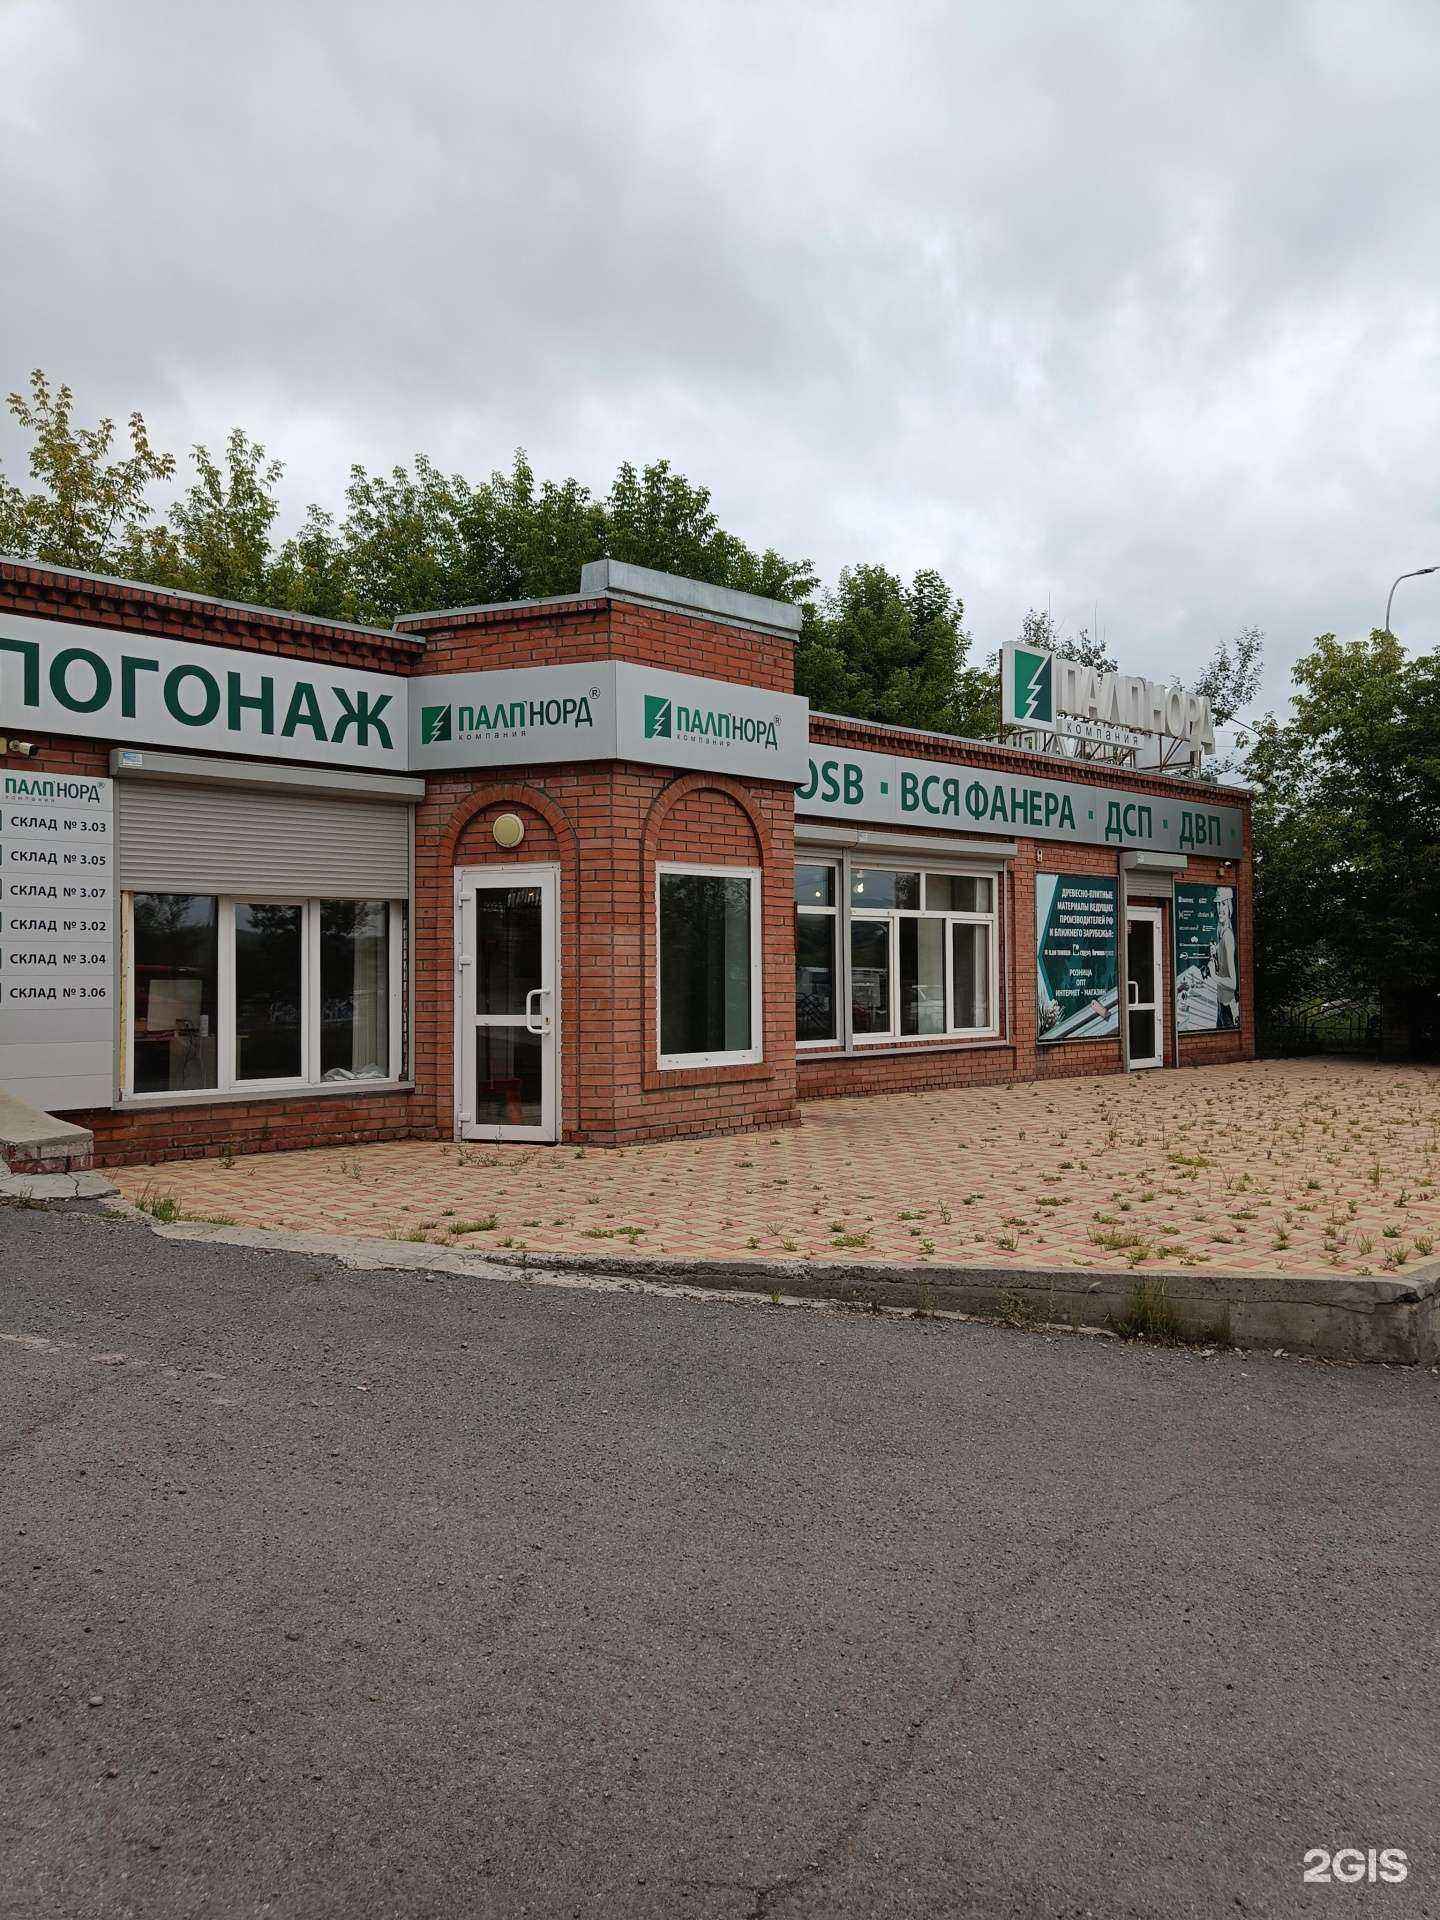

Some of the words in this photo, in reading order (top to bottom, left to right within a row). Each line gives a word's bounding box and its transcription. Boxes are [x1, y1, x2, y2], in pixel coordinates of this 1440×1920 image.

[0, 638, 394, 749] ПОГОНАЖ
[458, 730, 527, 741] компания
[1066, 723, 1139, 745] компания
[676, 735, 731, 747] компания
[10, 816, 58, 831] СКЛАД
[1105, 801, 1153, 843] ДСП
[1179, 812, 1222, 850] ДВП
[10, 850, 58, 865] СКЛАД
[10, 885, 58, 899] СКЛАД
[1057, 901, 1089, 912] МАТЕРИАЛЫ
[10, 919, 58, 932] СКЛАД
[1059, 914, 1105, 926] ПРОИЗВОДИТЕЛЕЙ
[1054, 928, 1083, 937] БЛИЖНЕГО
[10, 953, 58, 966] СКЛАД
[1069, 968, 1093, 977] РОЗНИЦА
[1075, 979, 1086, 987] ОПТ
[10, 987, 58, 1000] СКЛАД
